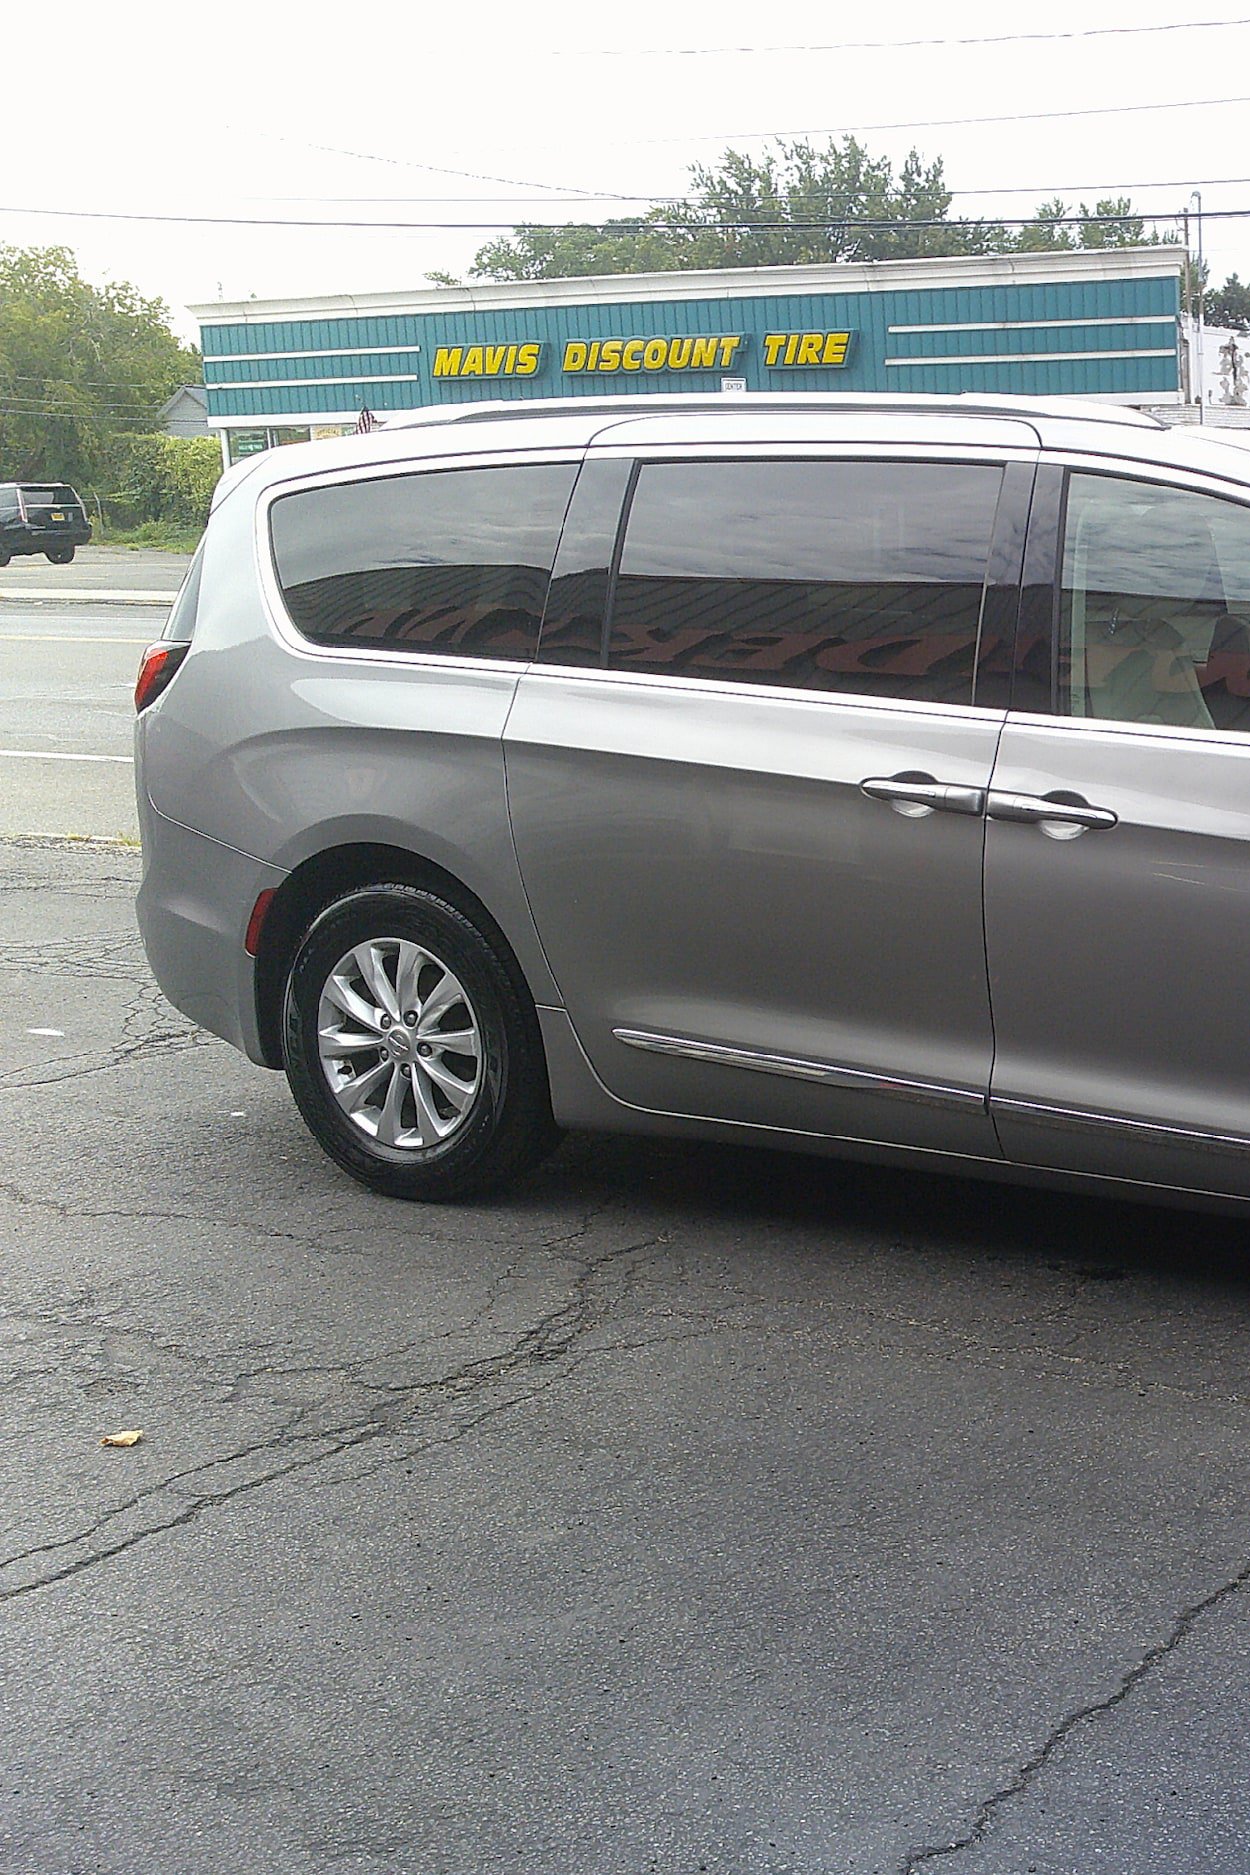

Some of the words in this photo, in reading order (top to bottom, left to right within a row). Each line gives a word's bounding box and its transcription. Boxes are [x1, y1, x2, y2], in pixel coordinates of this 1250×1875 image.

[433, 344, 540, 377] MAVIS
[562, 336, 740, 371] DISCOUNT
[764, 332, 850, 366] TIRE
